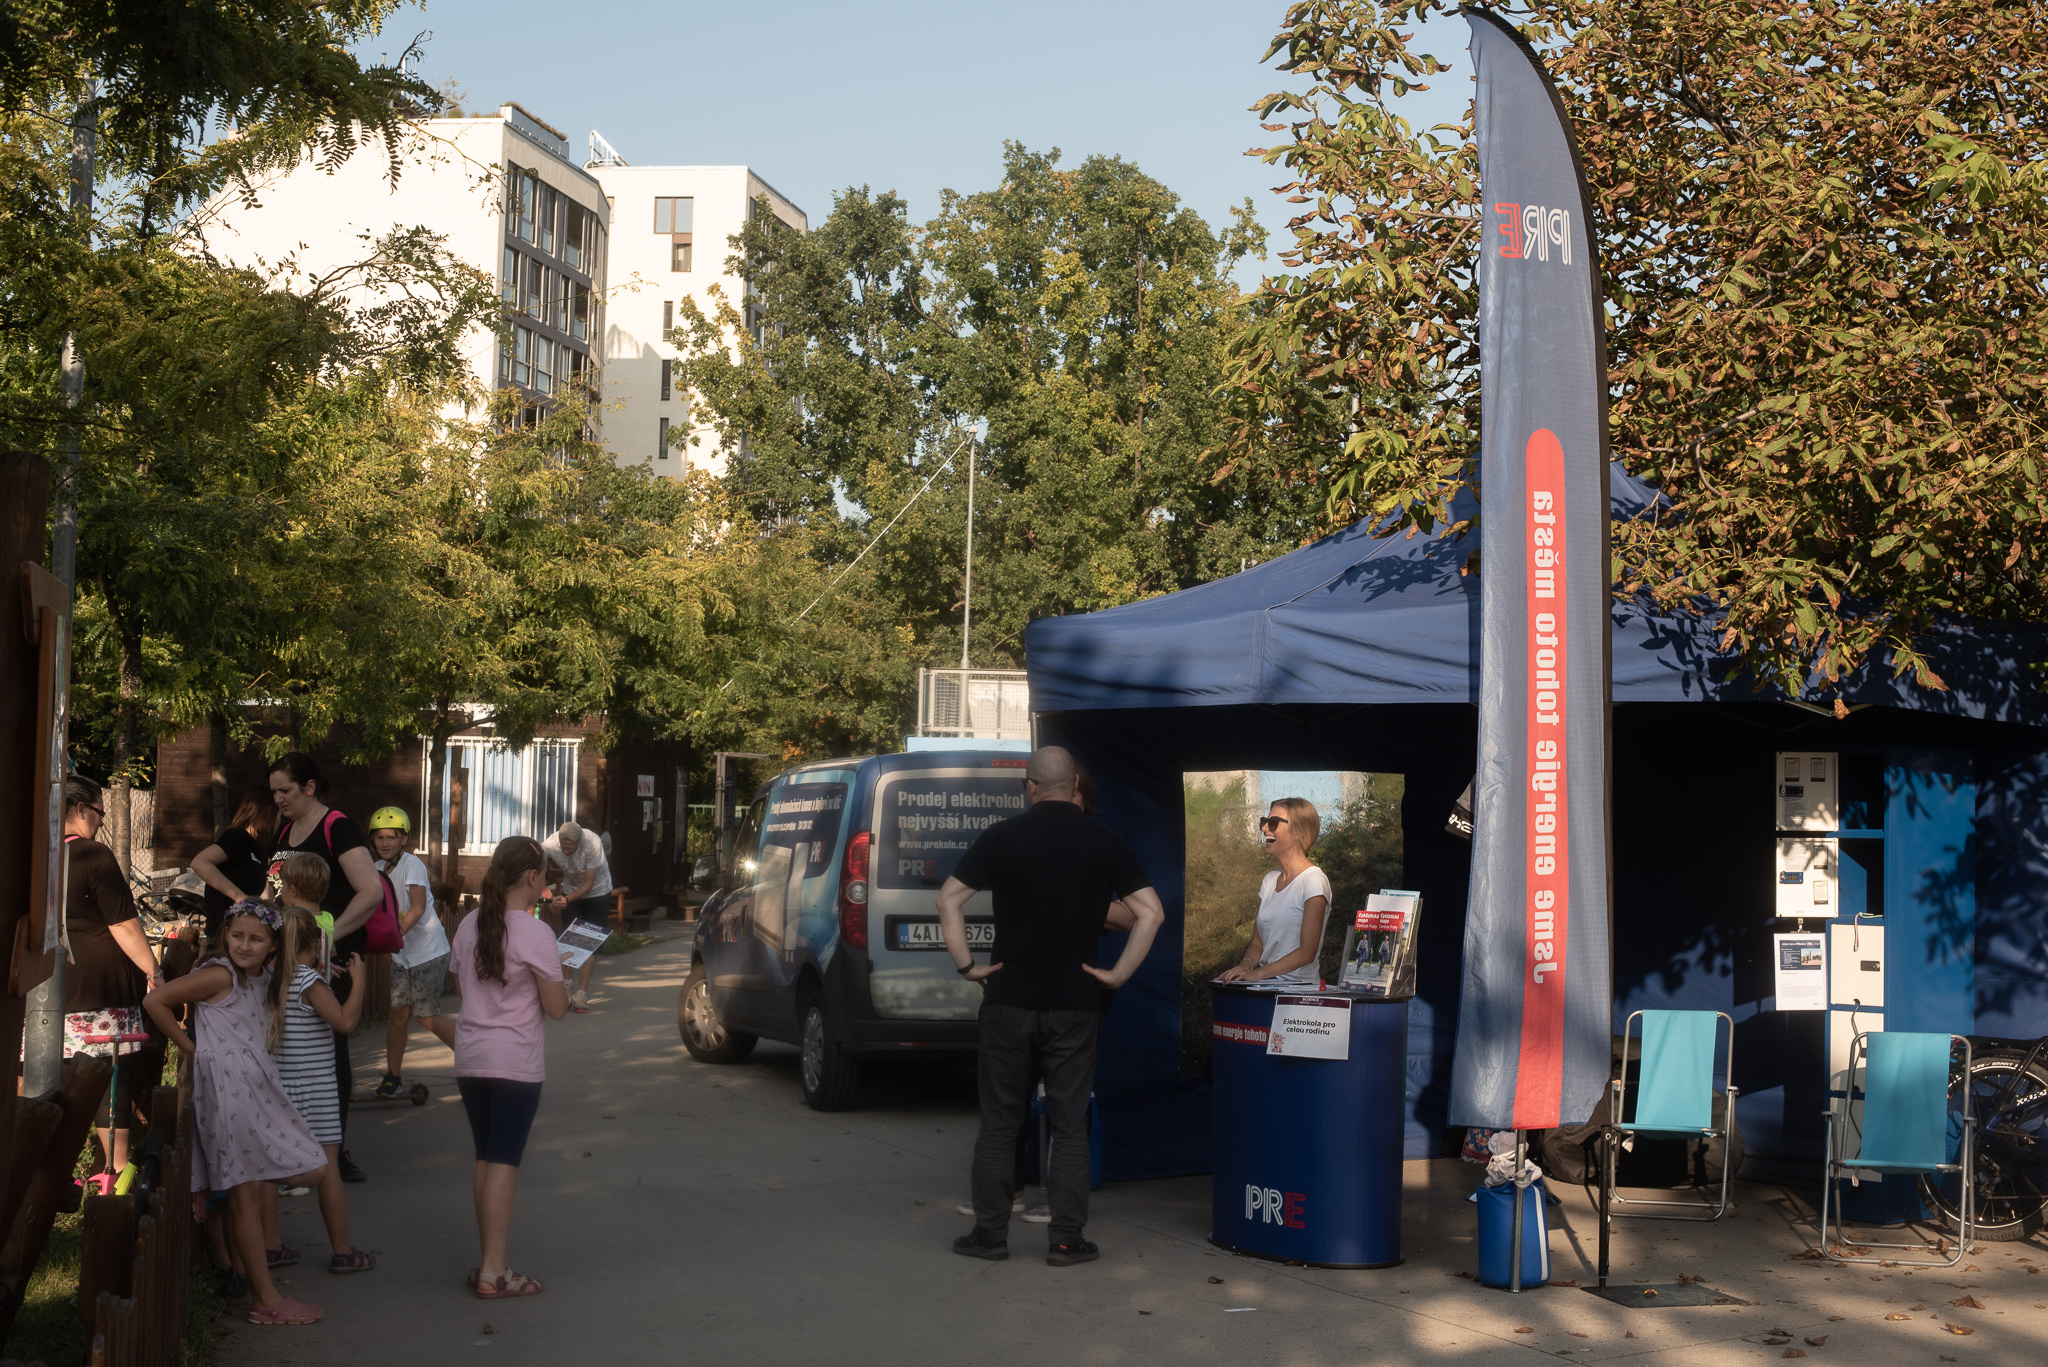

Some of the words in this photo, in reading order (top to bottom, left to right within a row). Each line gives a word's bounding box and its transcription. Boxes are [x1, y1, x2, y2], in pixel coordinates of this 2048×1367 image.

[898, 791, 947, 809] Prodej
[950, 792, 1025, 809] elektrokol
[898, 812, 960, 831] nejvyšší
[898, 840, 968, 850] www.prekolo.cz
[898, 859, 937, 876] PRE
[1283, 1018, 1322, 1027] Elektrokola
[1323, 1020, 1336, 1029] pro
[1286, 1026, 1305, 1034] celou
[1306, 1028, 1330, 1036] rodinu
[1244, 1028, 1267, 1042] tohoto
[1245, 1184, 1306, 1229] PRE
